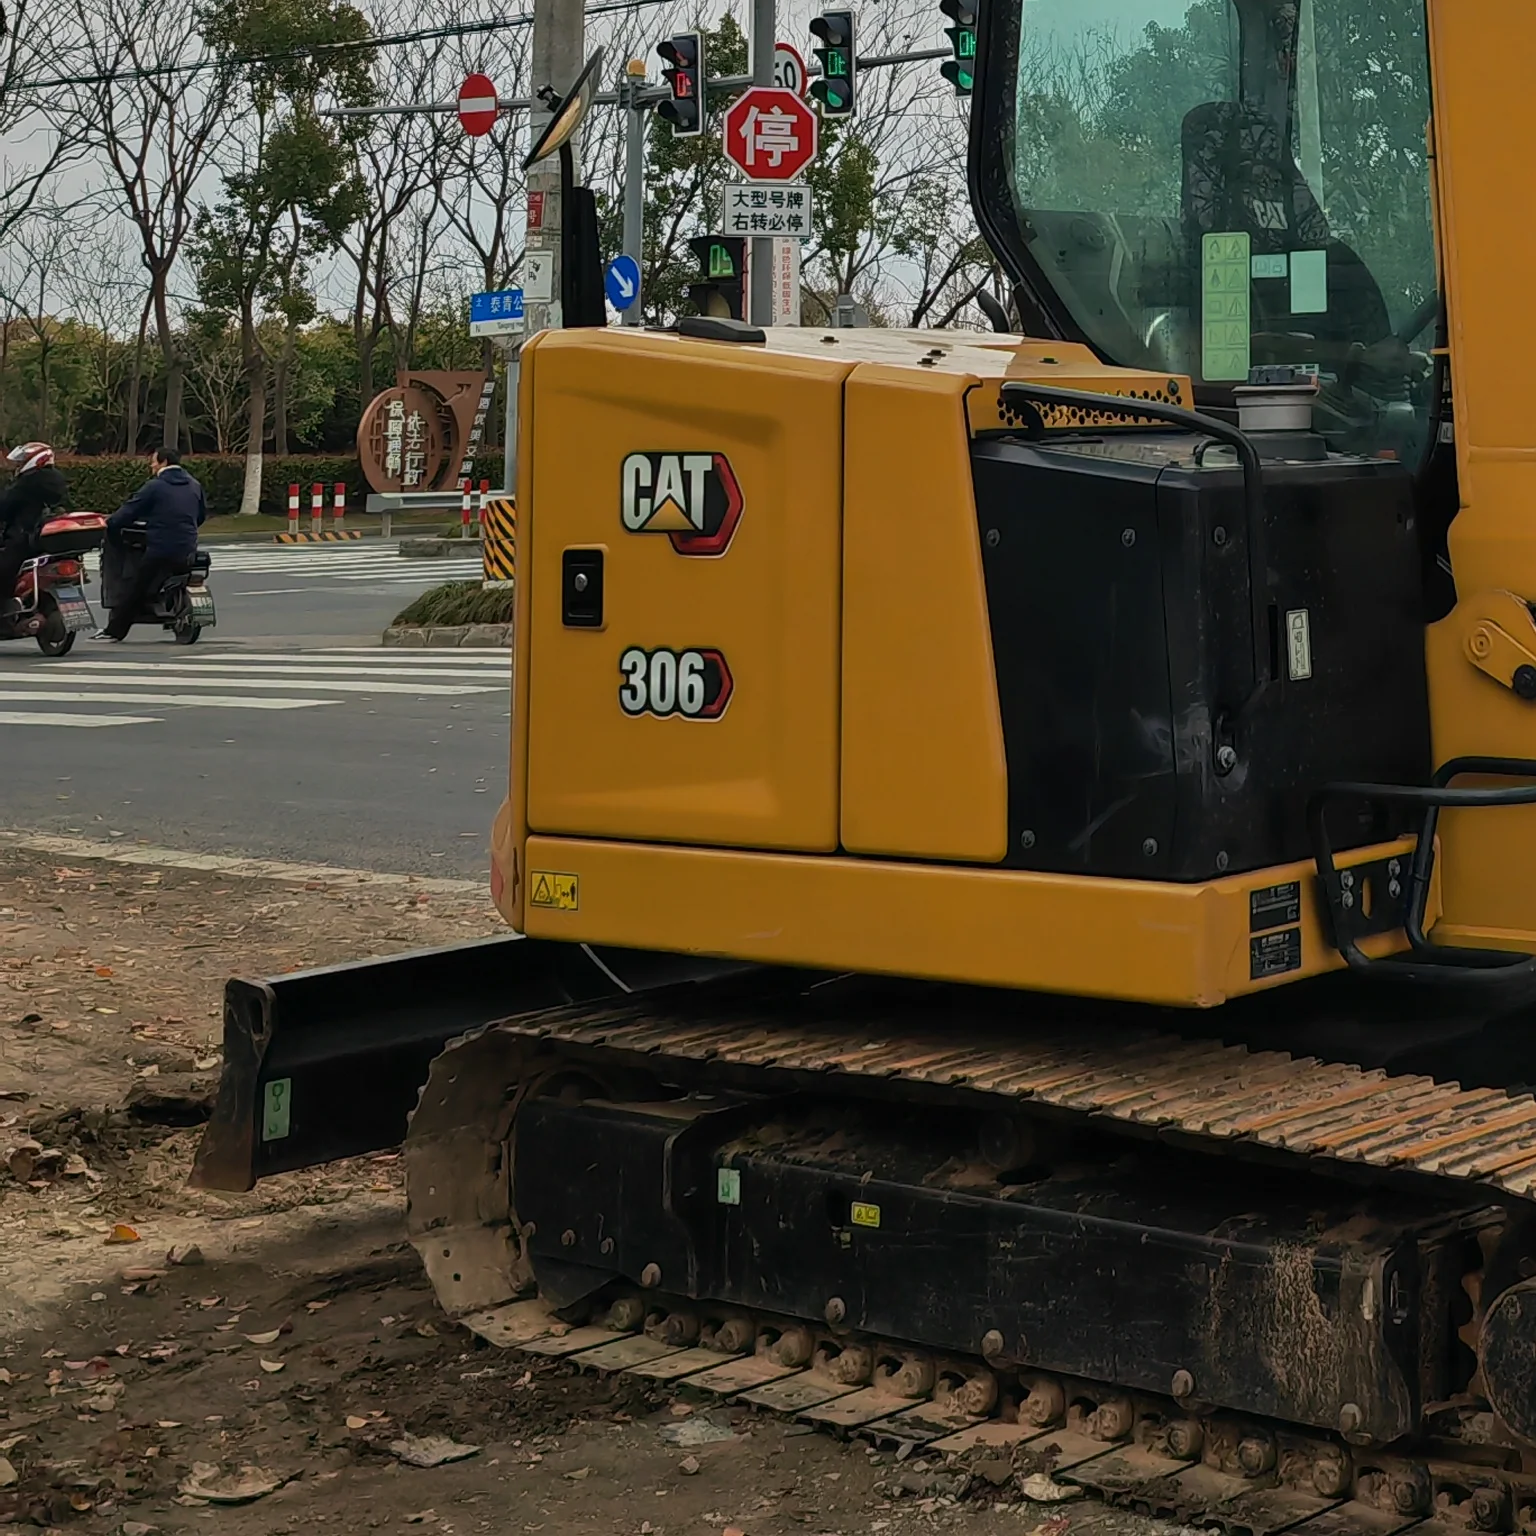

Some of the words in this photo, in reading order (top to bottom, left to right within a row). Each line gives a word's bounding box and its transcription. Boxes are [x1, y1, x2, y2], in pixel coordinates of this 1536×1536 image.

[739, 105, 799, 167] 停
[731, 212, 804, 232] 右转必停
[732, 190, 804, 210] 大型号牌
[1252, 199, 1289, 230] CAT
[623, 454, 713, 531] CAT
[620, 650, 705, 714] 306
